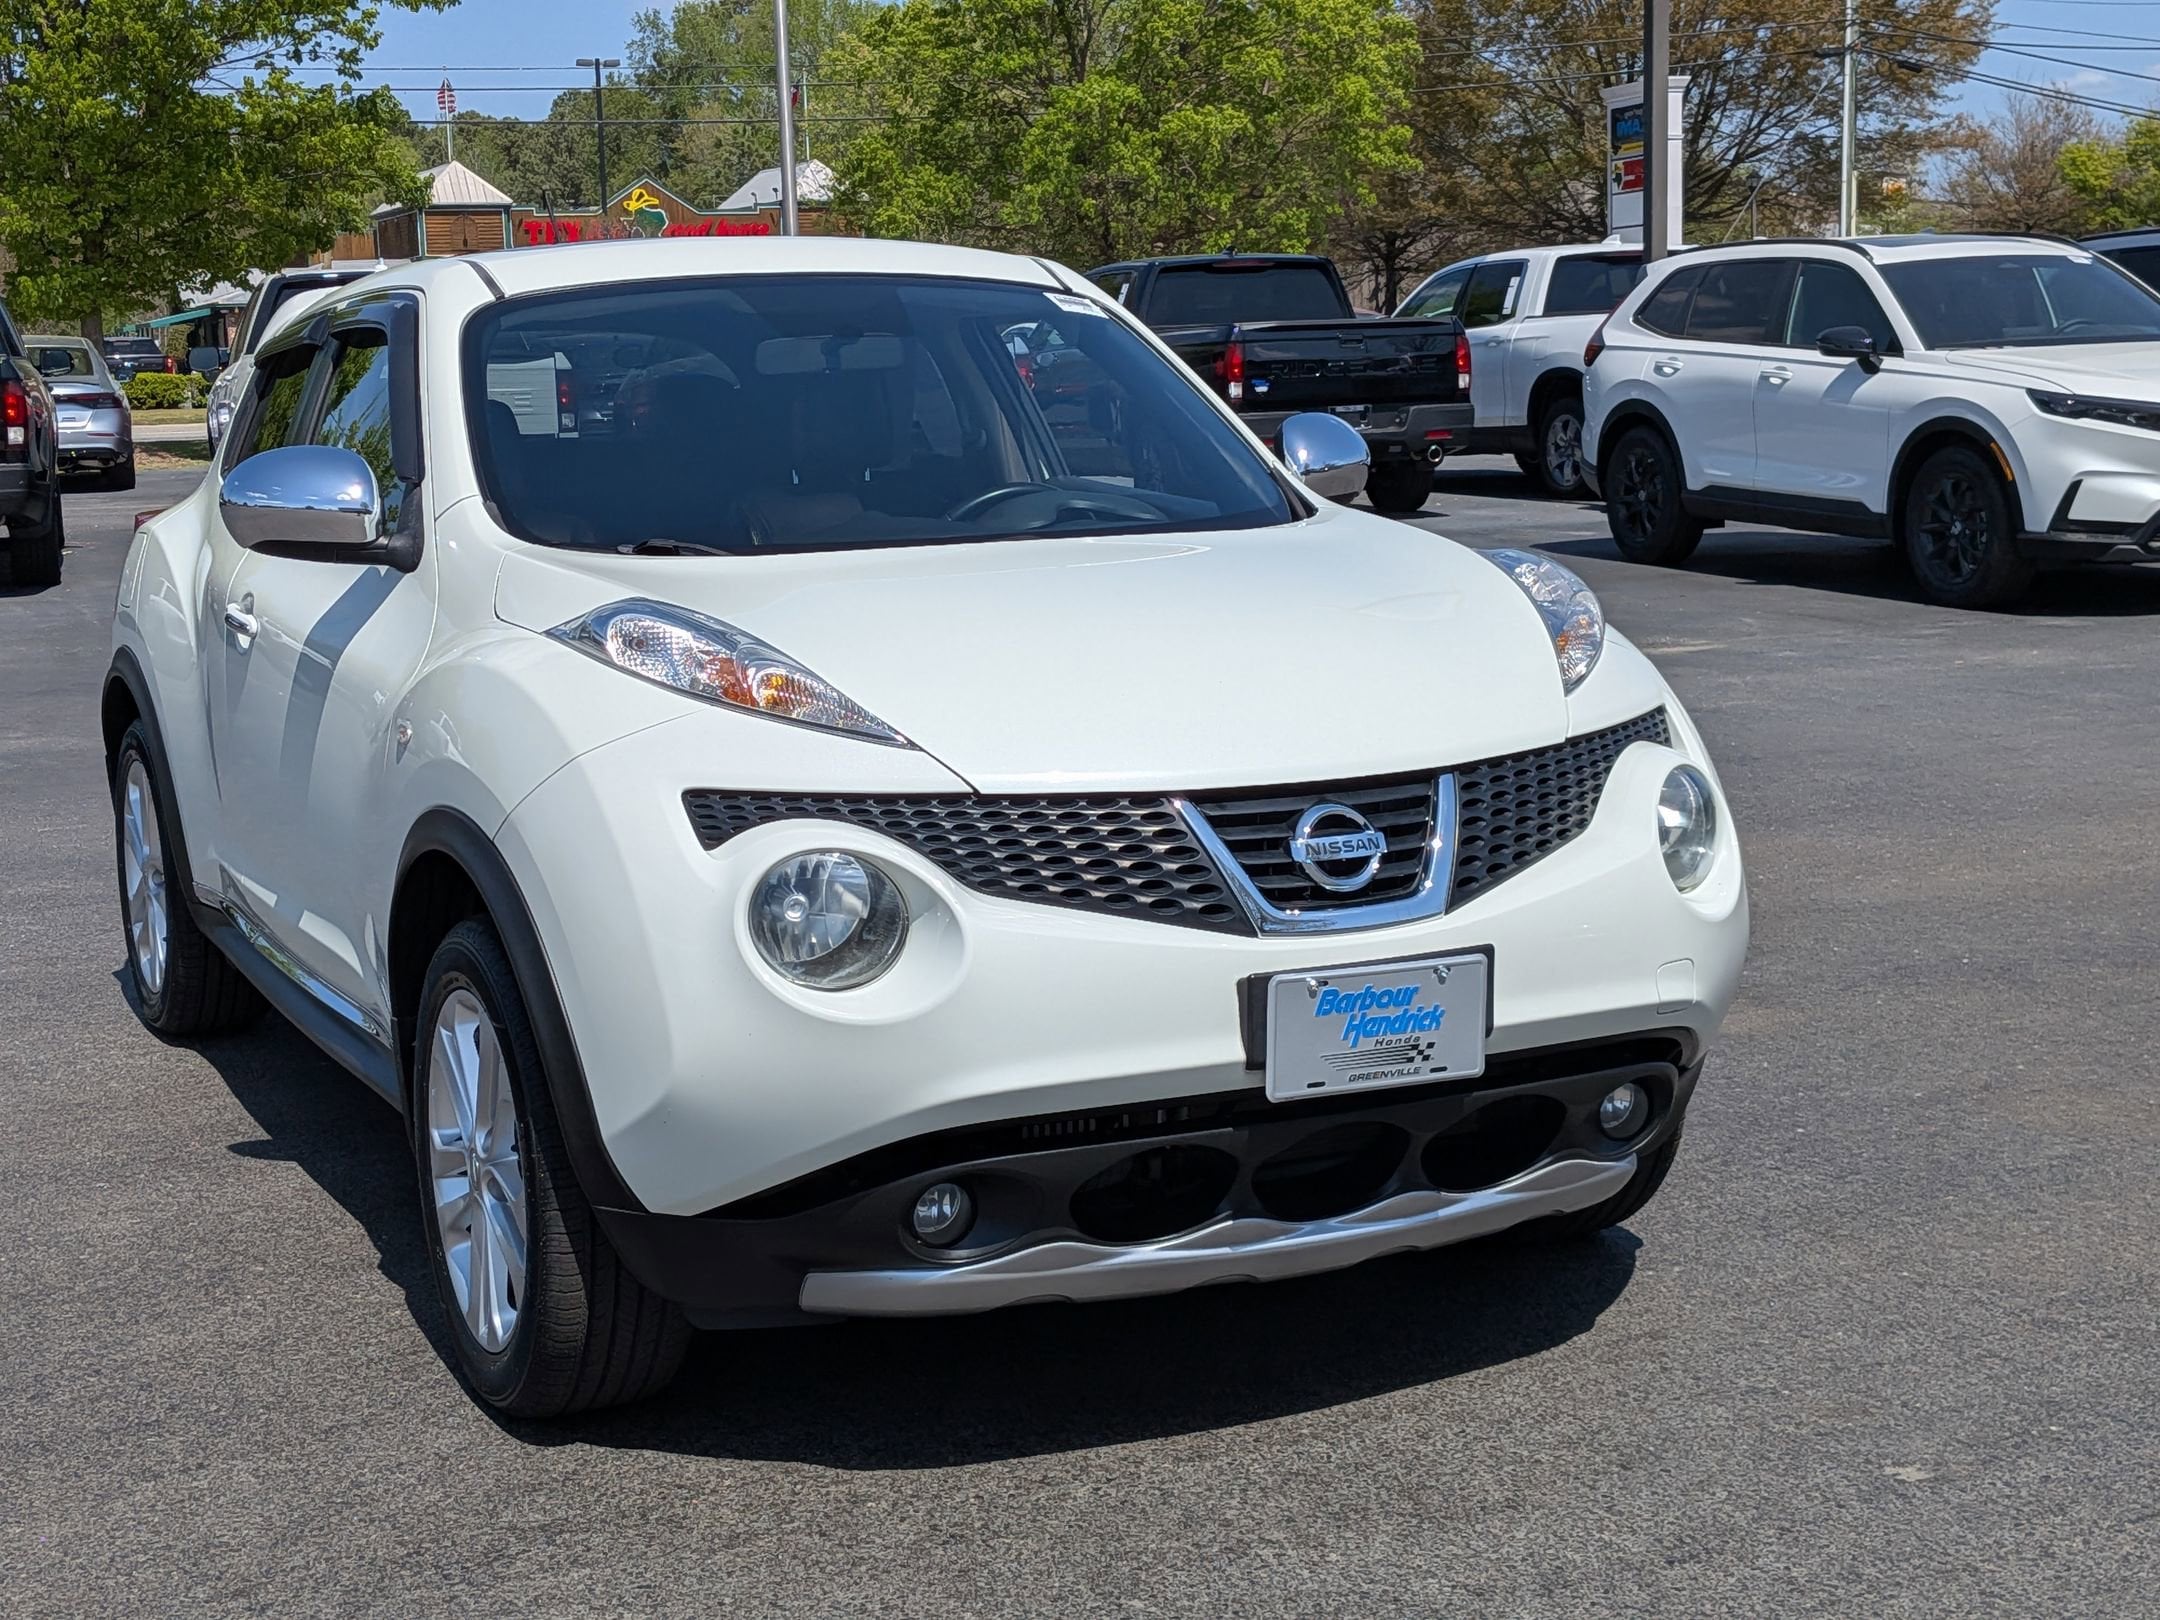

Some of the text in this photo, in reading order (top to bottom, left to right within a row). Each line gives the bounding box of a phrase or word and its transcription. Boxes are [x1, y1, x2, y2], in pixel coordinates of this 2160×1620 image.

[1305, 837, 1380, 856] NISSAN
[1315, 984, 1421, 1018] Barbour
[1342, 1005, 1446, 1049] Hendrick
[1374, 1034, 1421, 1047] Honda
[1348, 1066, 1422, 1083] GREENVILLE
